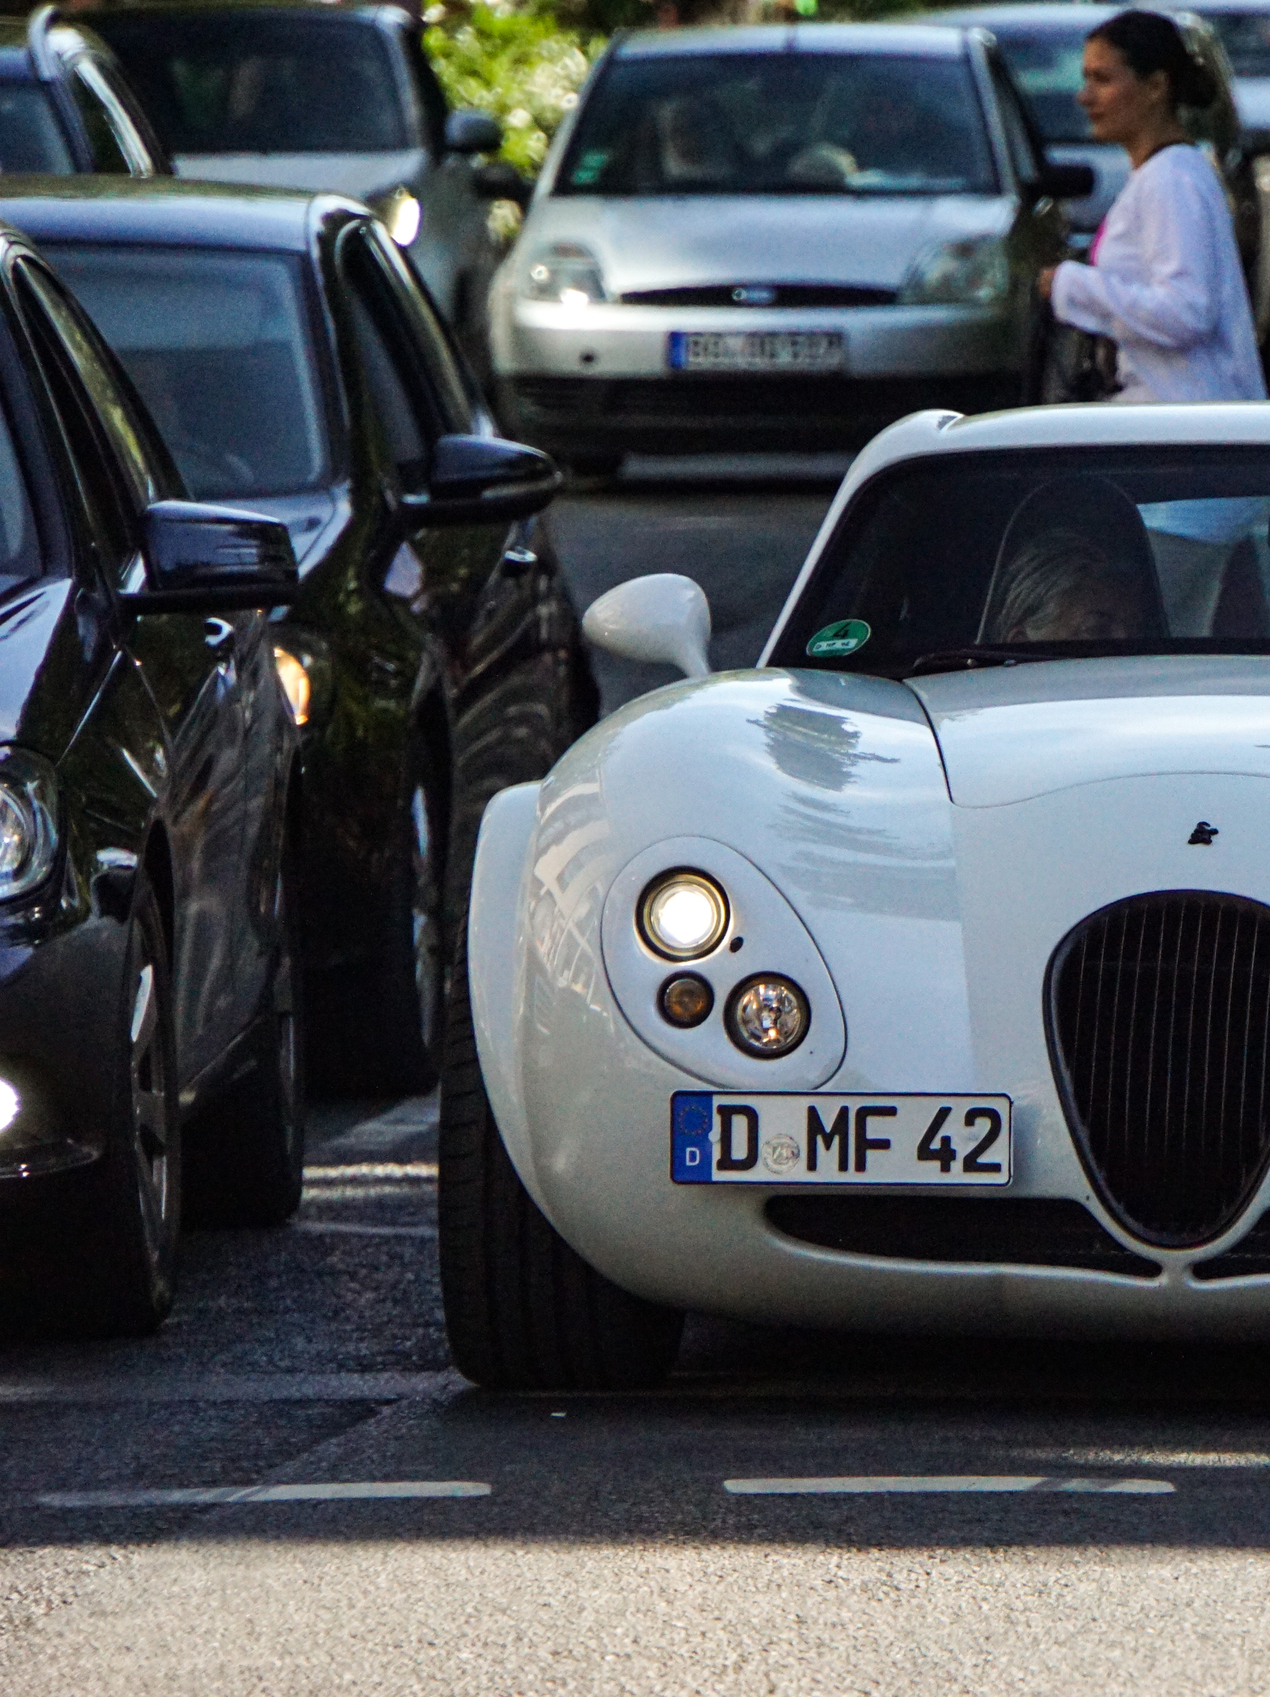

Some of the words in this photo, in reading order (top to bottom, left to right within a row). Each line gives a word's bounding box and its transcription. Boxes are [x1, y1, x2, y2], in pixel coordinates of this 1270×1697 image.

[832, 621, 853, 639] 4
[716, 1104, 759, 1171] D
[806, 1105, 898, 1173] MF
[917, 1106, 1002, 1173] 42
[686, 1147, 700, 1166] D
